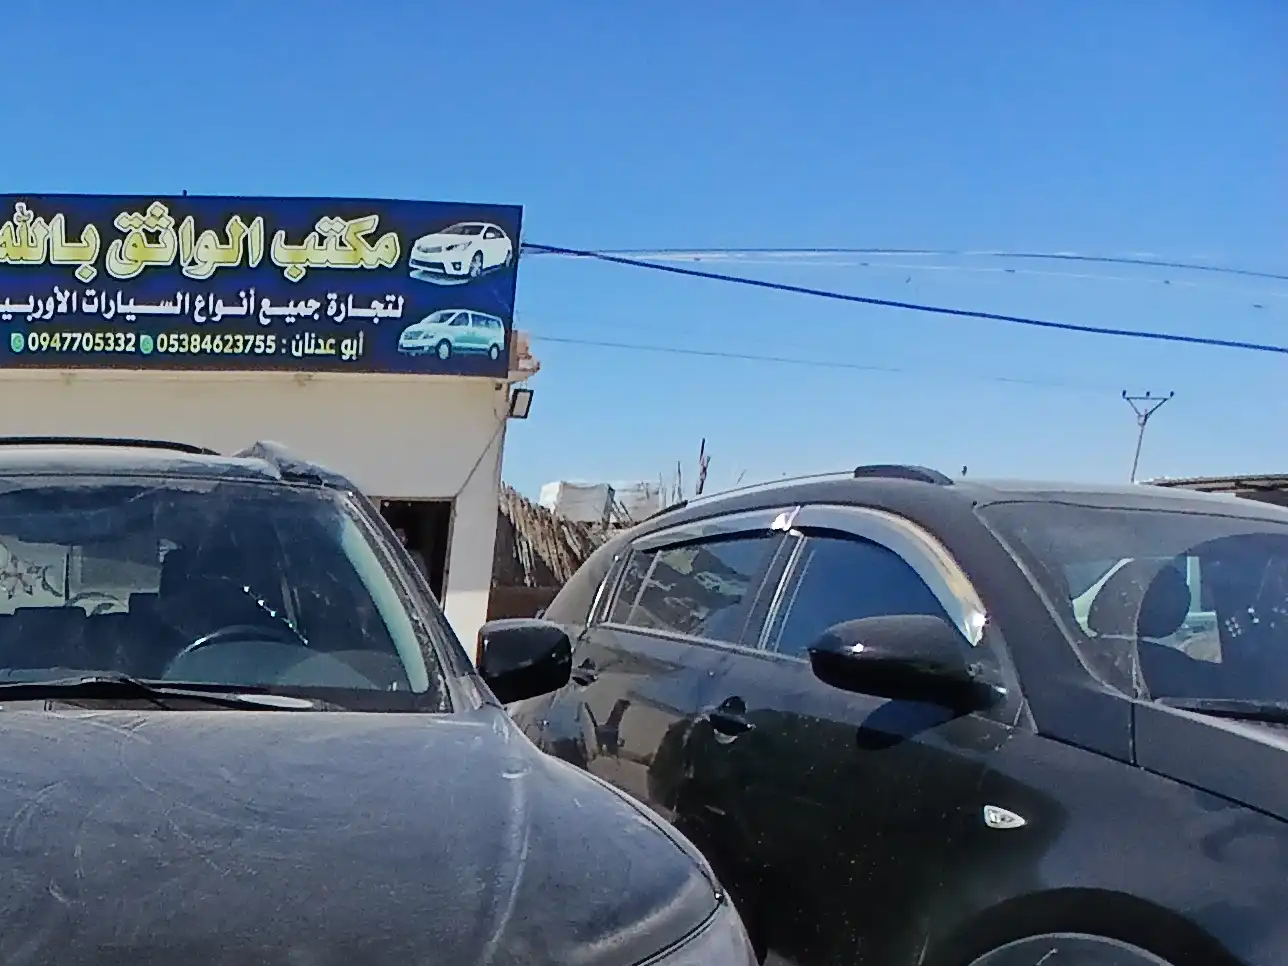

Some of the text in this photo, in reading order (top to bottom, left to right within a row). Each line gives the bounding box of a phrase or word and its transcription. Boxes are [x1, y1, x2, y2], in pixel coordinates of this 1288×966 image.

[106, 201, 264, 280] الواثق
[271, 215, 401, 282] مكتب
[82, 289, 190, 320] السيارات
[194, 287, 255, 323] أنواع
[259, 298, 321, 325] جميع
[327, 293, 404, 324] لتجارة
[27, 332, 136, 353] 0947705332
[157, 333, 276, 355] 05384623755
[291, 332, 336, 357] عدنان
[340, 331, 364, 360] أبو
